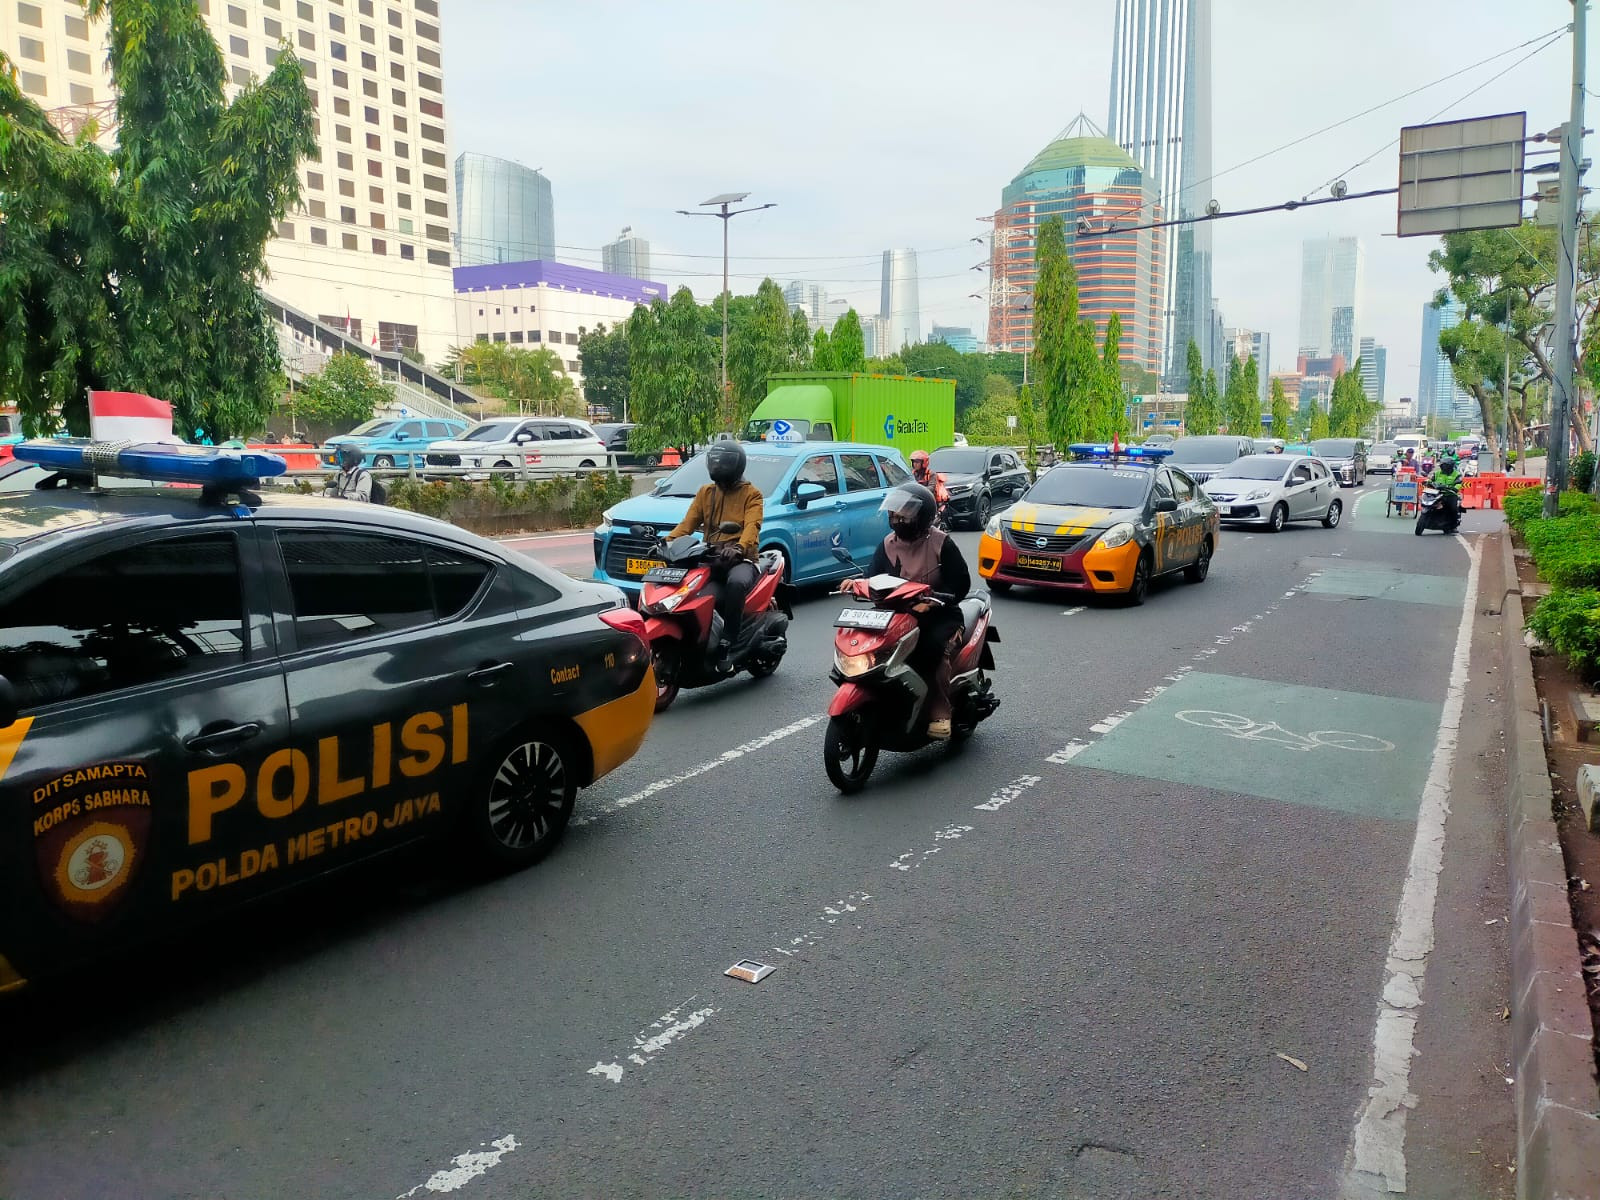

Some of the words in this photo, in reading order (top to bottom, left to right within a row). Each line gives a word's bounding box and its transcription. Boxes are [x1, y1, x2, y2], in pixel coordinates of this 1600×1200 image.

[550, 663, 580, 685] Contact
[604, 652, 615, 669] 110
[33, 764, 148, 804] DITSAMAPTA
[187, 702, 469, 846] POLISI
[33, 798, 81, 837] KORPS
[84, 788, 150, 811] SABHARA
[171, 843, 279, 901] POLDA
[287, 810, 378, 865] METRO
[382, 791, 441, 830] JAYA
